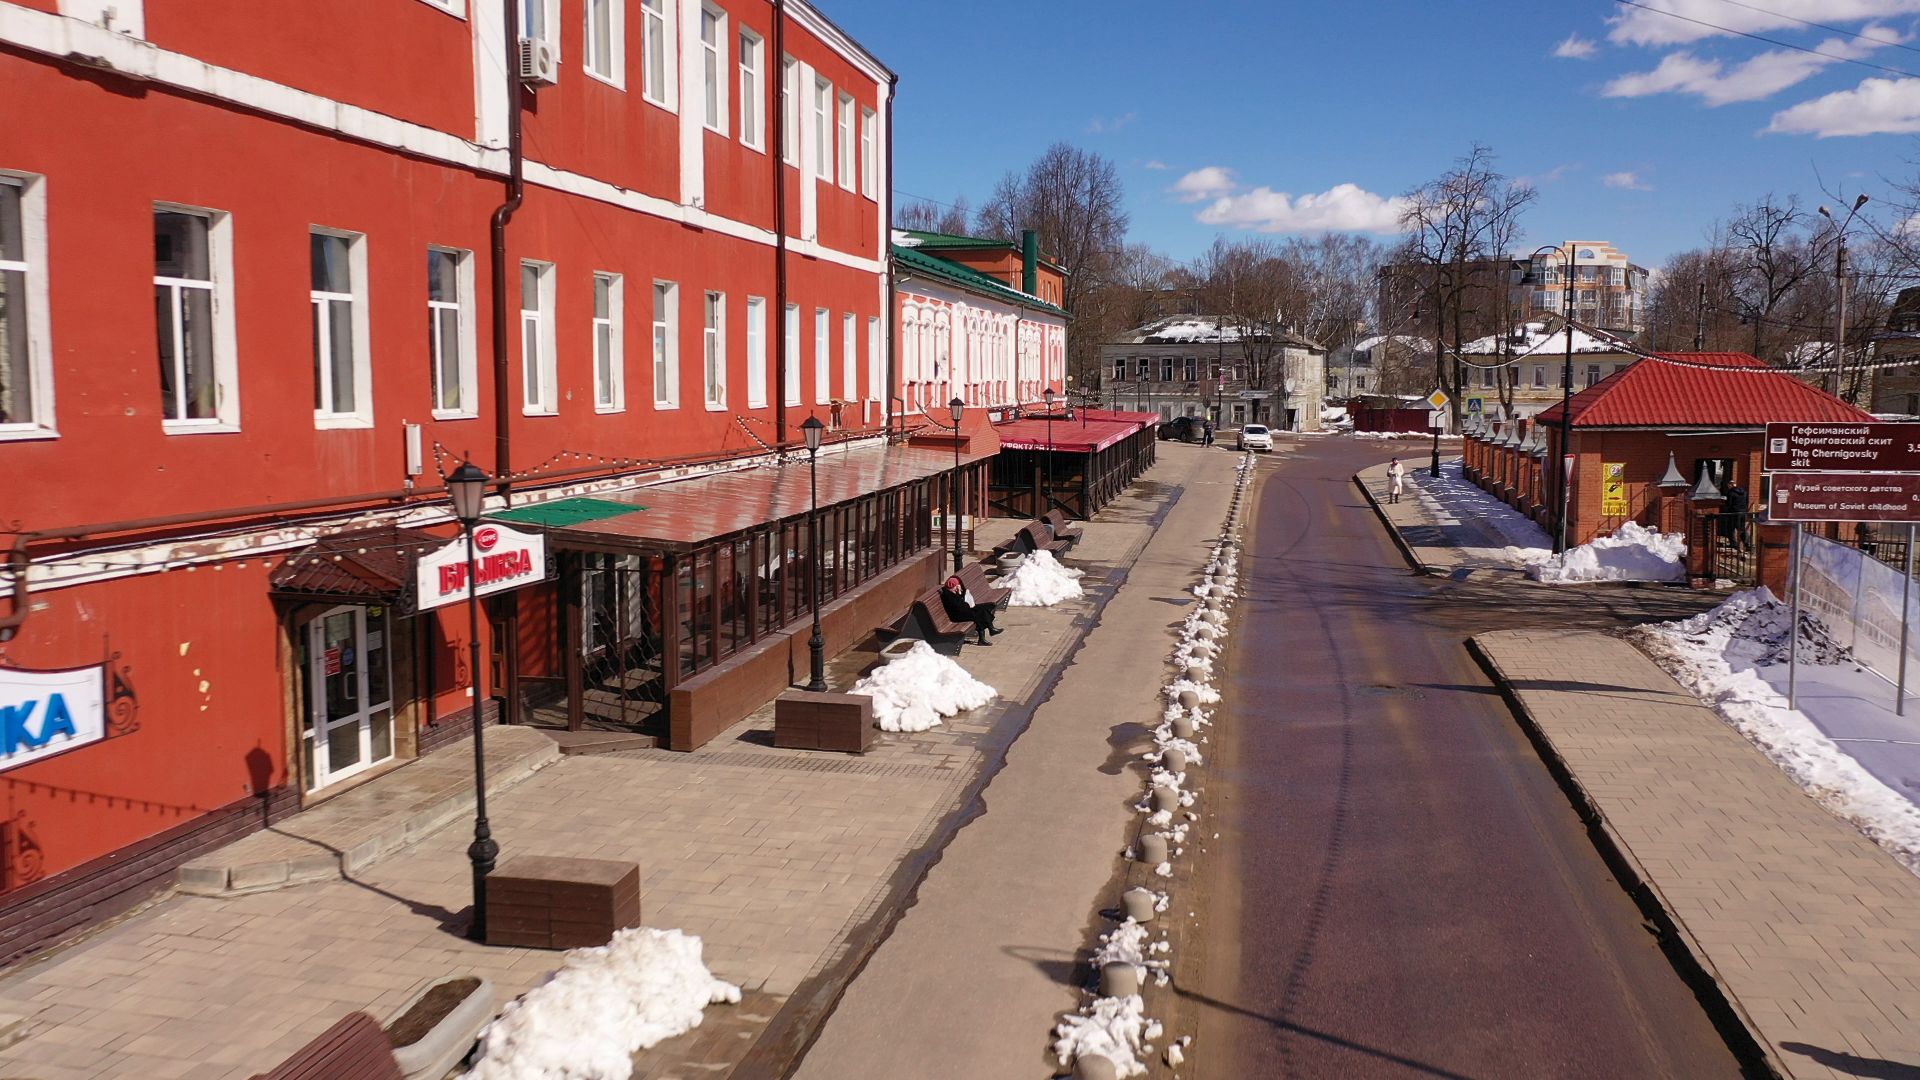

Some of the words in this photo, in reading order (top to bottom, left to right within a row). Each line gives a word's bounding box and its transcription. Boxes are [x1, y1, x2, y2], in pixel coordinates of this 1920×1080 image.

[1791, 426, 1870, 436] Гефсиманский
[1791, 436, 1866, 446] Черниговский
[1868, 438, 1893, 446] скит
[1791, 449, 1809, 458] The
[1812, 449, 1878, 460] Chernigovsky
[1791, 458, 1811, 467] skit
[1794, 484, 1820, 493] Музей
[1793, 502, 1826, 510] Museum
[1829, 502, 1837, 510] of
[1839, 502, 1865, 510] Soviet
[1867, 503, 1907, 511] childhood
